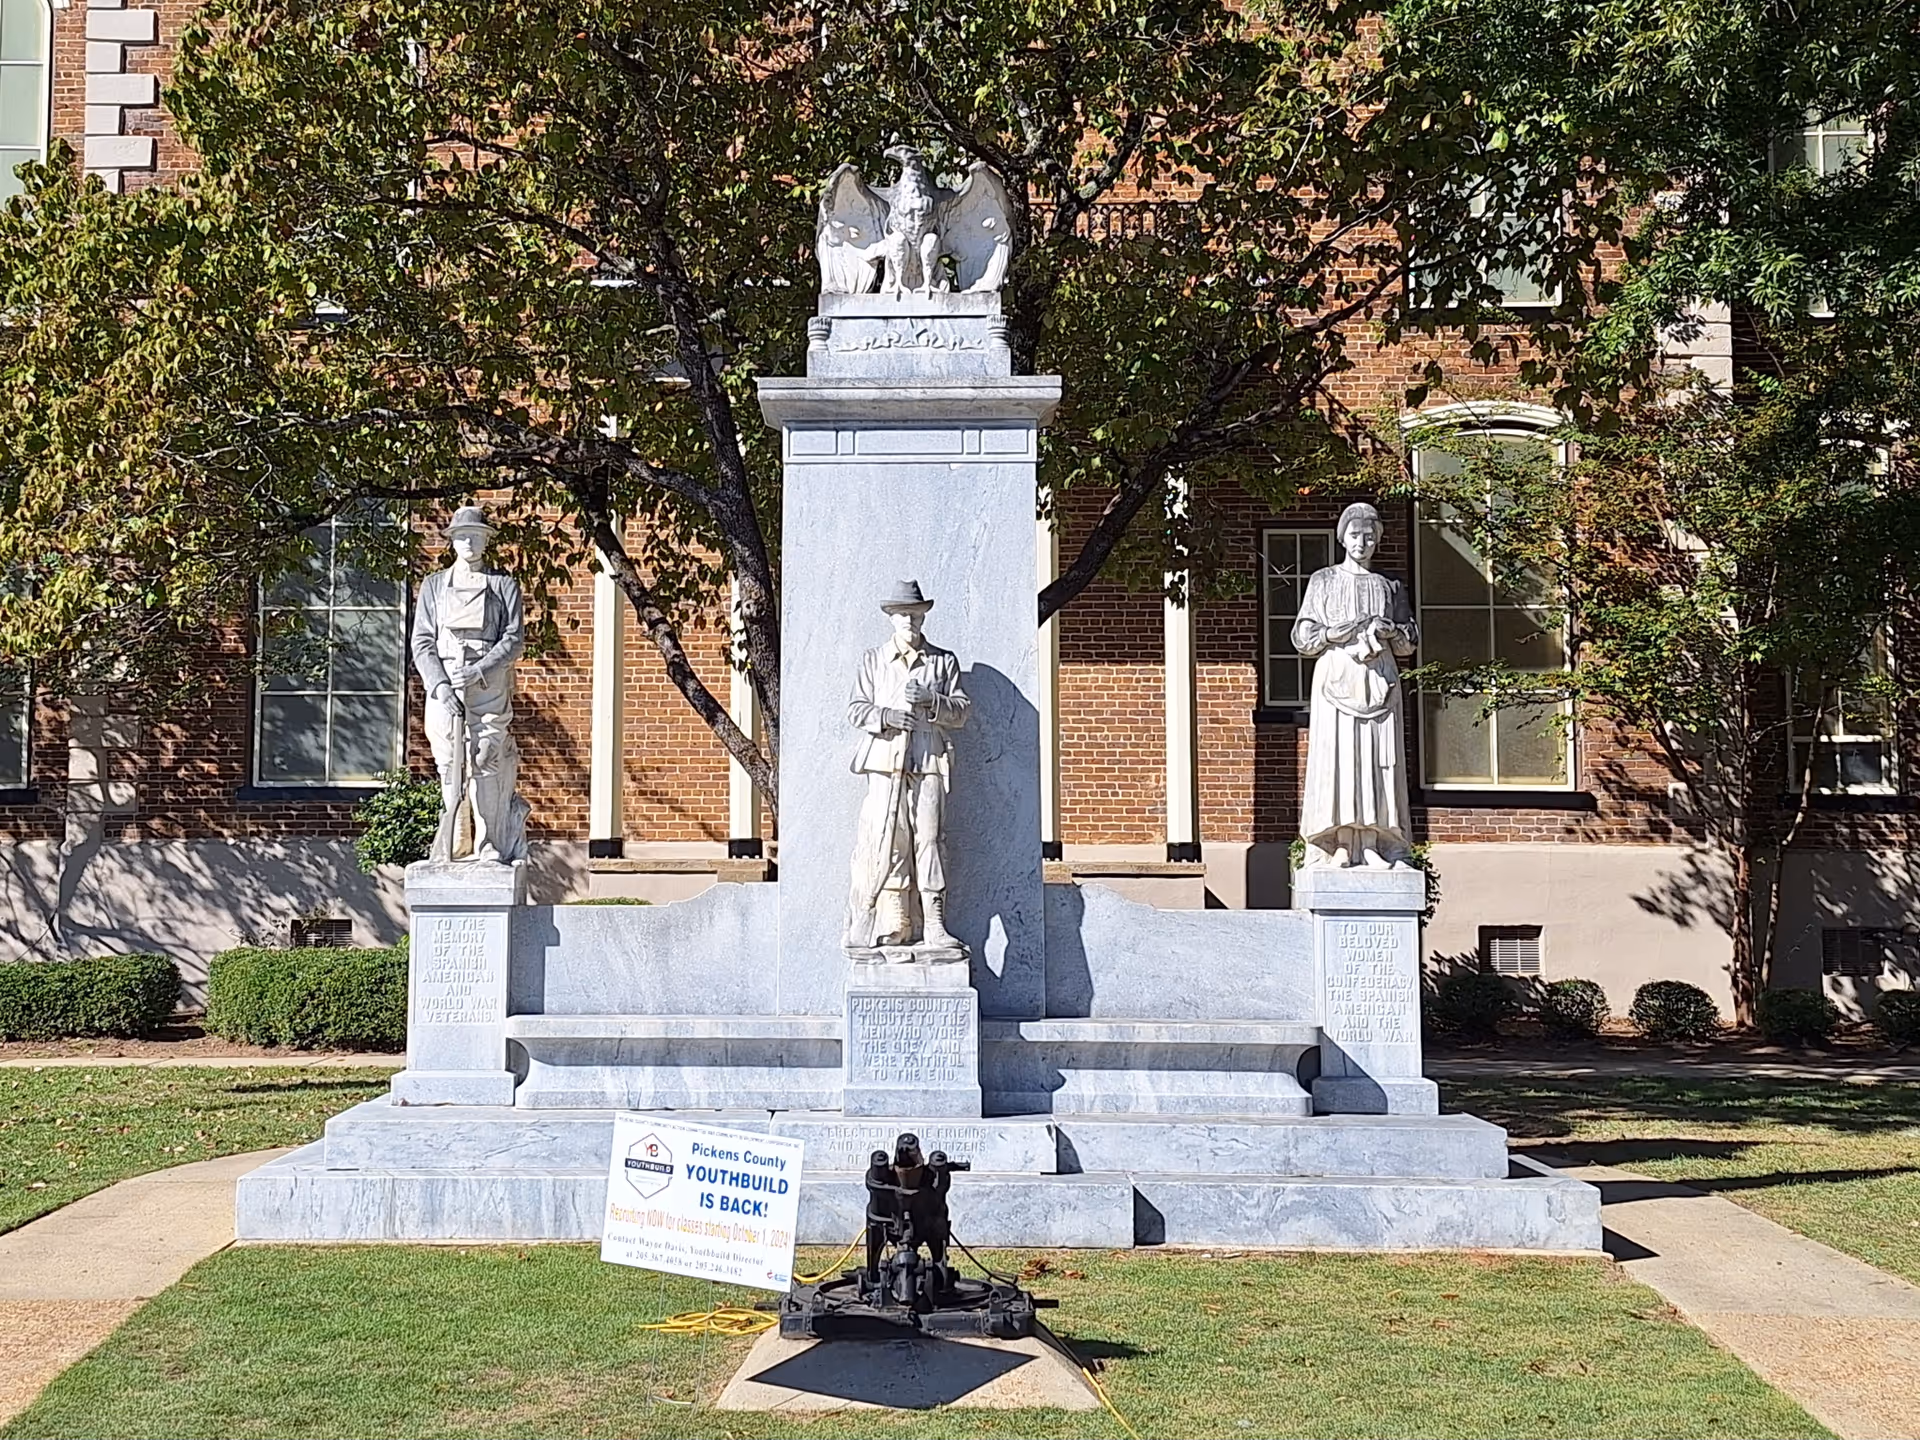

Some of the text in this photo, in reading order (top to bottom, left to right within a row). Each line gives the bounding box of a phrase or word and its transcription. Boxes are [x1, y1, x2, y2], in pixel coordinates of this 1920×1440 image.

[435, 918, 486, 931] TO THE
[1340, 922, 1395, 935] TO OUR
[433, 931, 487, 944] MEMORY
[1339, 936, 1399, 949] BELOVED
[434, 944, 485, 957] OF THE
[1345, 949, 1394, 962] WOMEN
[432, 957, 487, 970] SPANISH
[1345, 963, 1395, 976] OF THE
[421, 971, 496, 983] AMERICAN
[1327, 976, 1414, 989] CONFEDERACY
[446, 984, 472, 996] AND
[1328, 989, 1414, 1003] THE SPANISH
[420, 997, 498, 1010] WORLD WAR
[852, 998, 905, 1012] PICKENS
[1333, 1003, 1407, 1016] AMERICAN
[859, 1012, 967, 1026] TRIBUTE TO THE
[1342, 1016, 1401, 1030] AND THE
[860, 1026, 965, 1040] MEN WHO WORE
[1330, 1029, 1373, 1042] WORLD
[861, 1040, 961, 1054] THE GREY AND
[862, 1054, 965, 1068] WERE FAITHFUL
[872, 1068, 888, 1081] TO
[896, 1068, 921, 1081] THE
[828, 1127, 883, 1138] ERECTED
[937, 1127, 987, 1139] FRIENDS
[828, 1140, 853, 1152] AND
[930, 1141, 986, 1152] CITIZENS
[691, 1142, 787, 1172] Pickens County
[847, 1153, 861, 1165] OF
[686, 1163, 789, 1195] YOUTHBUILD
[699, 1191, 769, 1218] IS BACK!
[609, 1203, 645, 1228] Recruiting
[646, 1208, 666, 1229] NOW
[665, 1211, 676, 1230] for
[676, 1213, 703, 1235] classes
[704, 1217, 731, 1243] starting
[732, 1222, 760, 1244] October
[607, 1232, 636, 1244] Contact
[638, 1236, 662, 1249] Wayne
[690, 1244, 730, 1261] Youthbuild
[732, 1252, 764, 1267] Director
[625, 1250, 633, 1258] at
